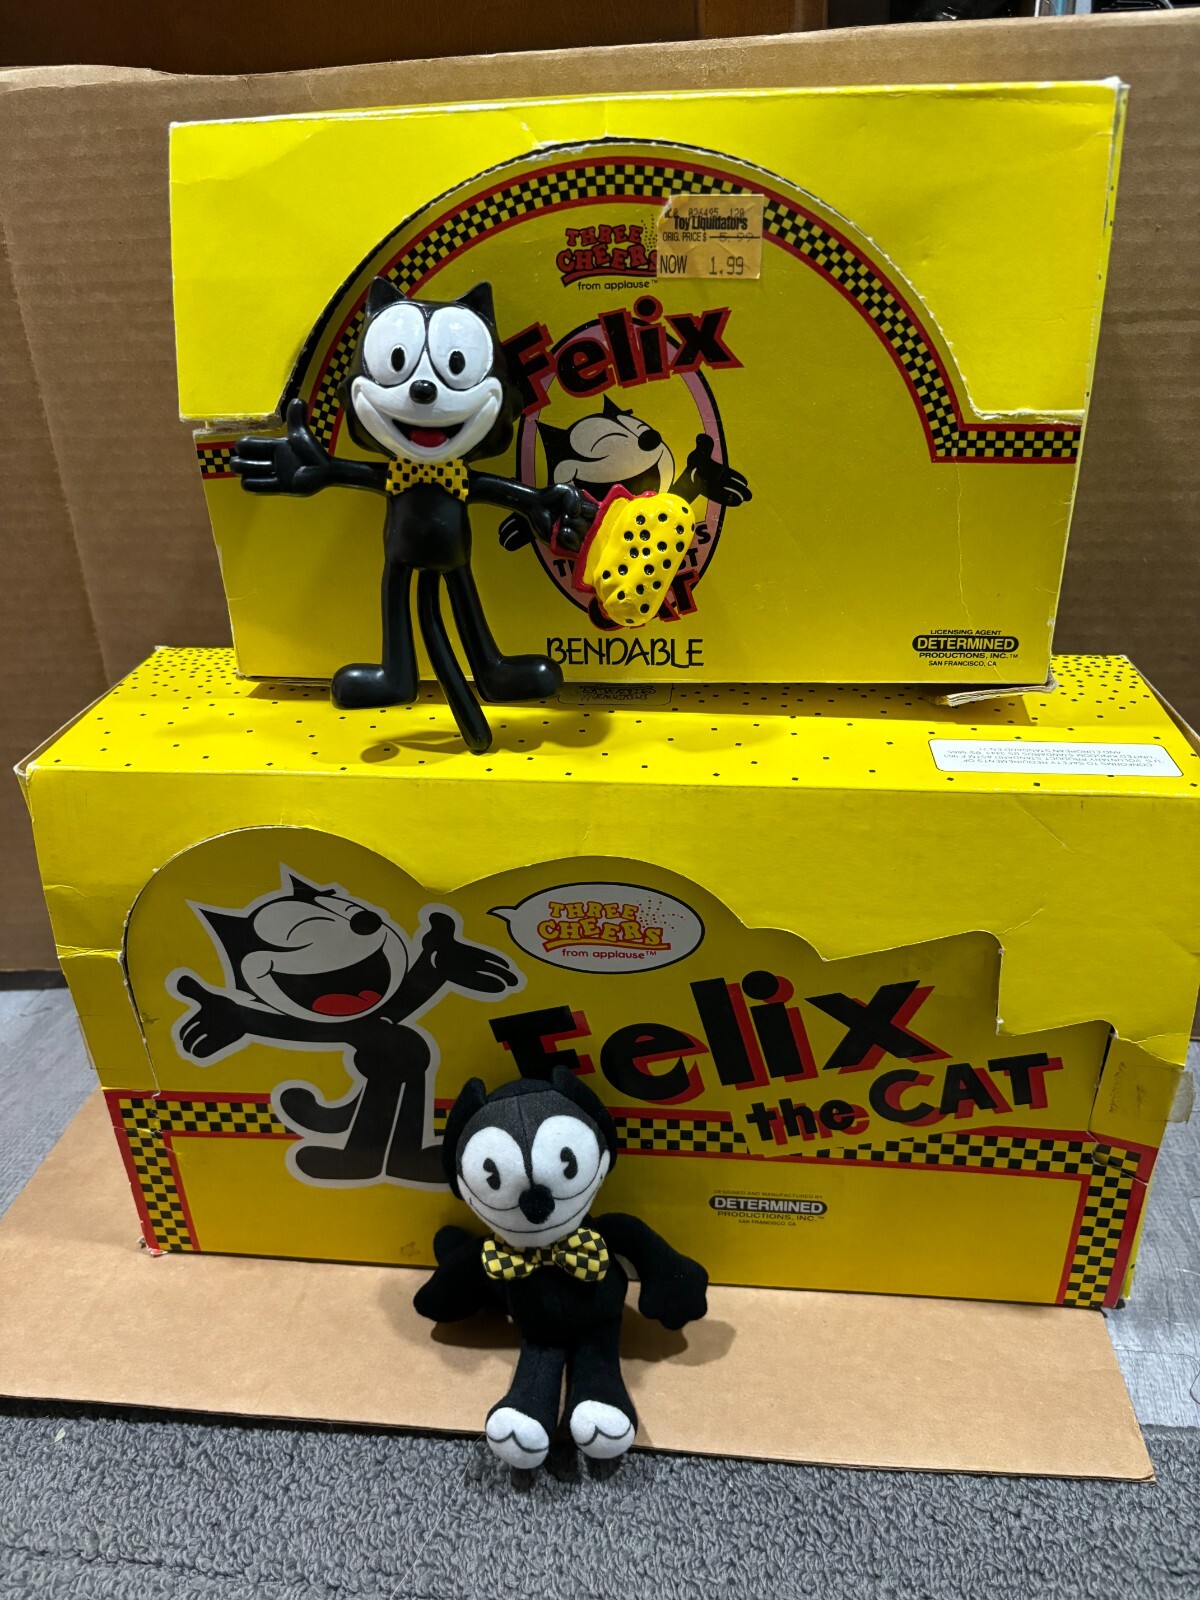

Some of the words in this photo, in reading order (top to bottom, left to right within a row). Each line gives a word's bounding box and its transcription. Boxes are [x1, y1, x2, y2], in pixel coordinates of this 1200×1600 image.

[674, 216, 690, 231] Toy
[692, 215, 748, 231] Liquidators
[565, 224, 643, 246] THREE
[682, 232, 701, 241] PRICE
[660, 255, 687, 274] NOW
[709, 256, 744, 275] 1.99
[578, 281, 601, 290] from
[501, 295, 744, 416] Felix
[546, 637, 704, 669] BENDABLE
[917, 637, 1014, 650] DETERMINED
[548, 901, 639, 921] THREE
[537, 917, 664, 946] CHEERS
[562, 949, 589, 957] from
[489, 970, 952, 1105] Felix
[746, 1097, 869, 1145] the
[869, 1052, 1063, 1127] CAT
[714, 1196, 823, 1214] DETERMINED
